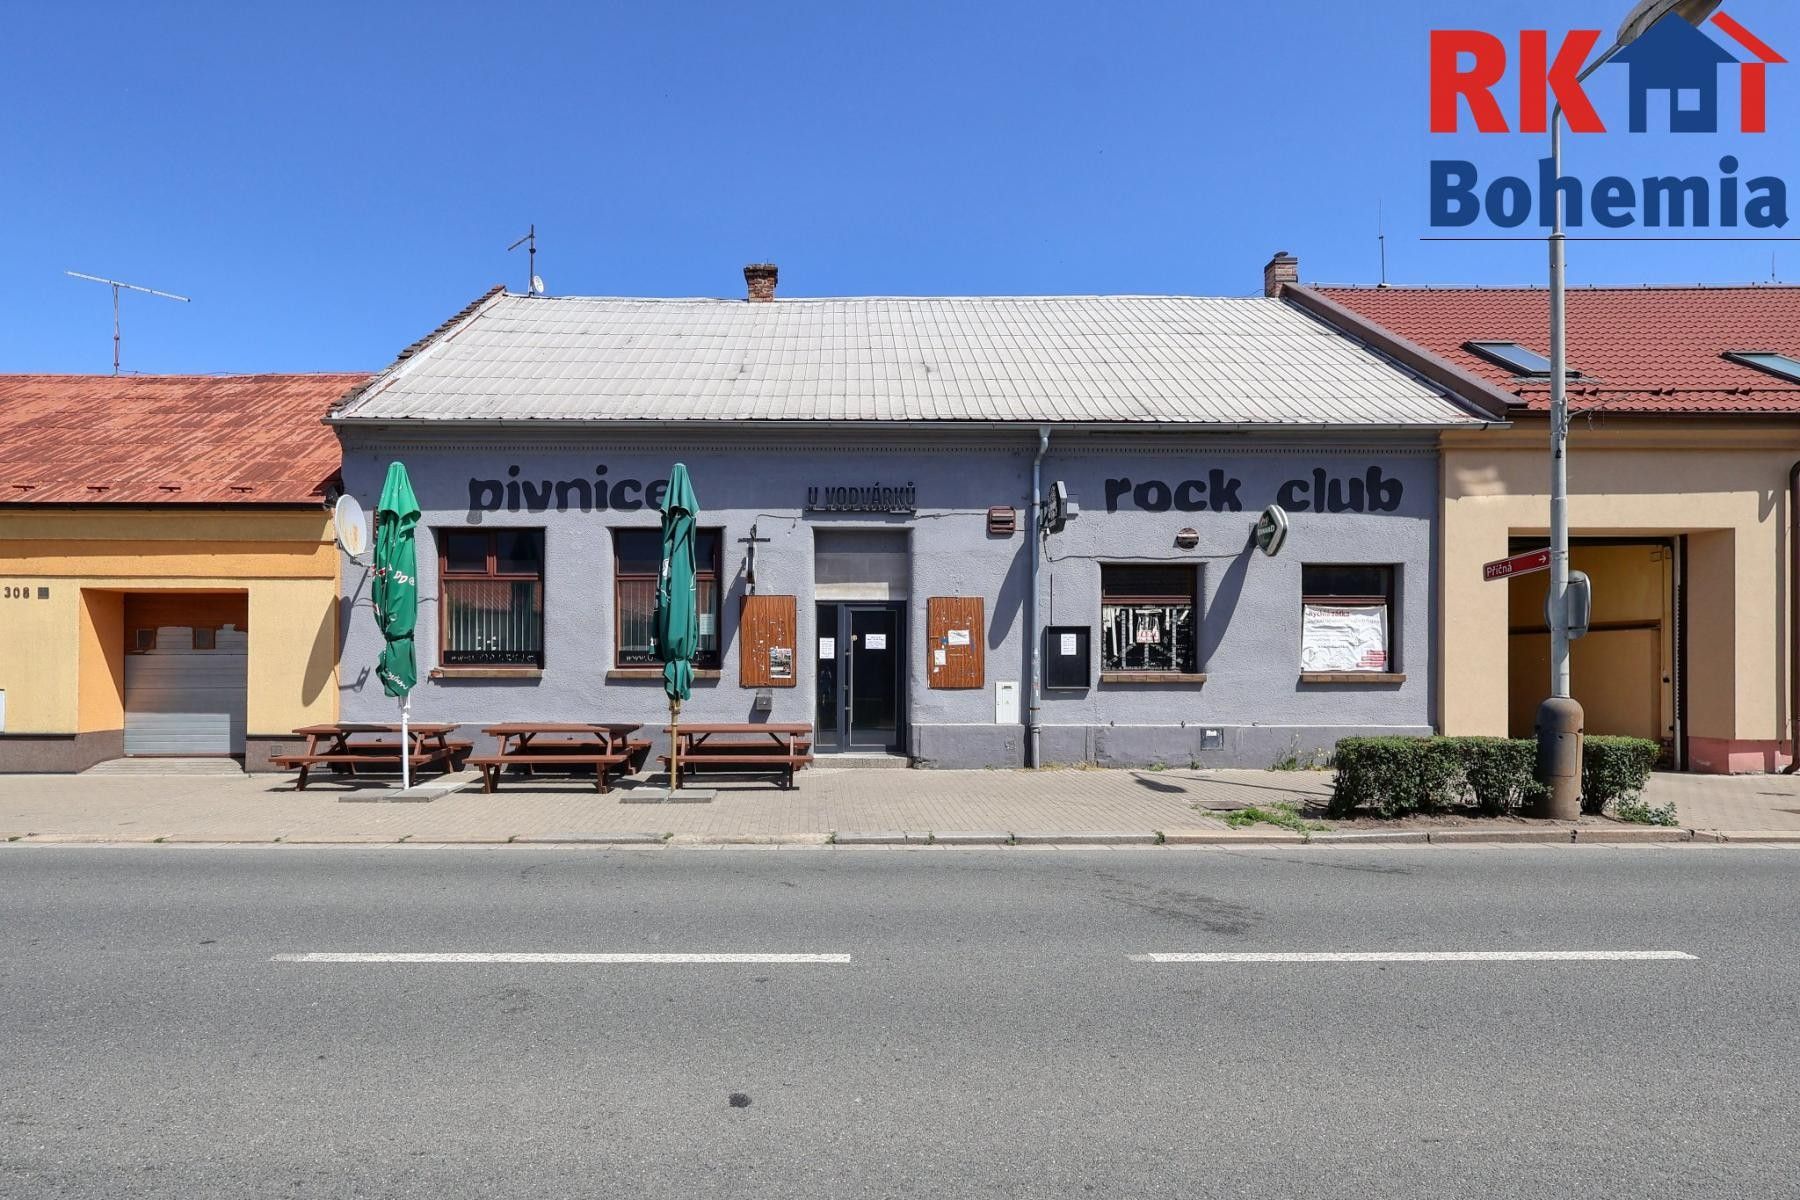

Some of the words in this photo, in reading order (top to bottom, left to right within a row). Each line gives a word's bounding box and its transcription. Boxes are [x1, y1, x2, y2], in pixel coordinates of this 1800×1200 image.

[807, 486, 818, 505] U
[825, 481, 916, 506] VODVÁRKŮ
[1105, 468, 1243, 513] rock
[1276, 466, 1403, 513] club
[1486, 562, 1513, 577] Příčná
[4, 586, 30, 599] 308
